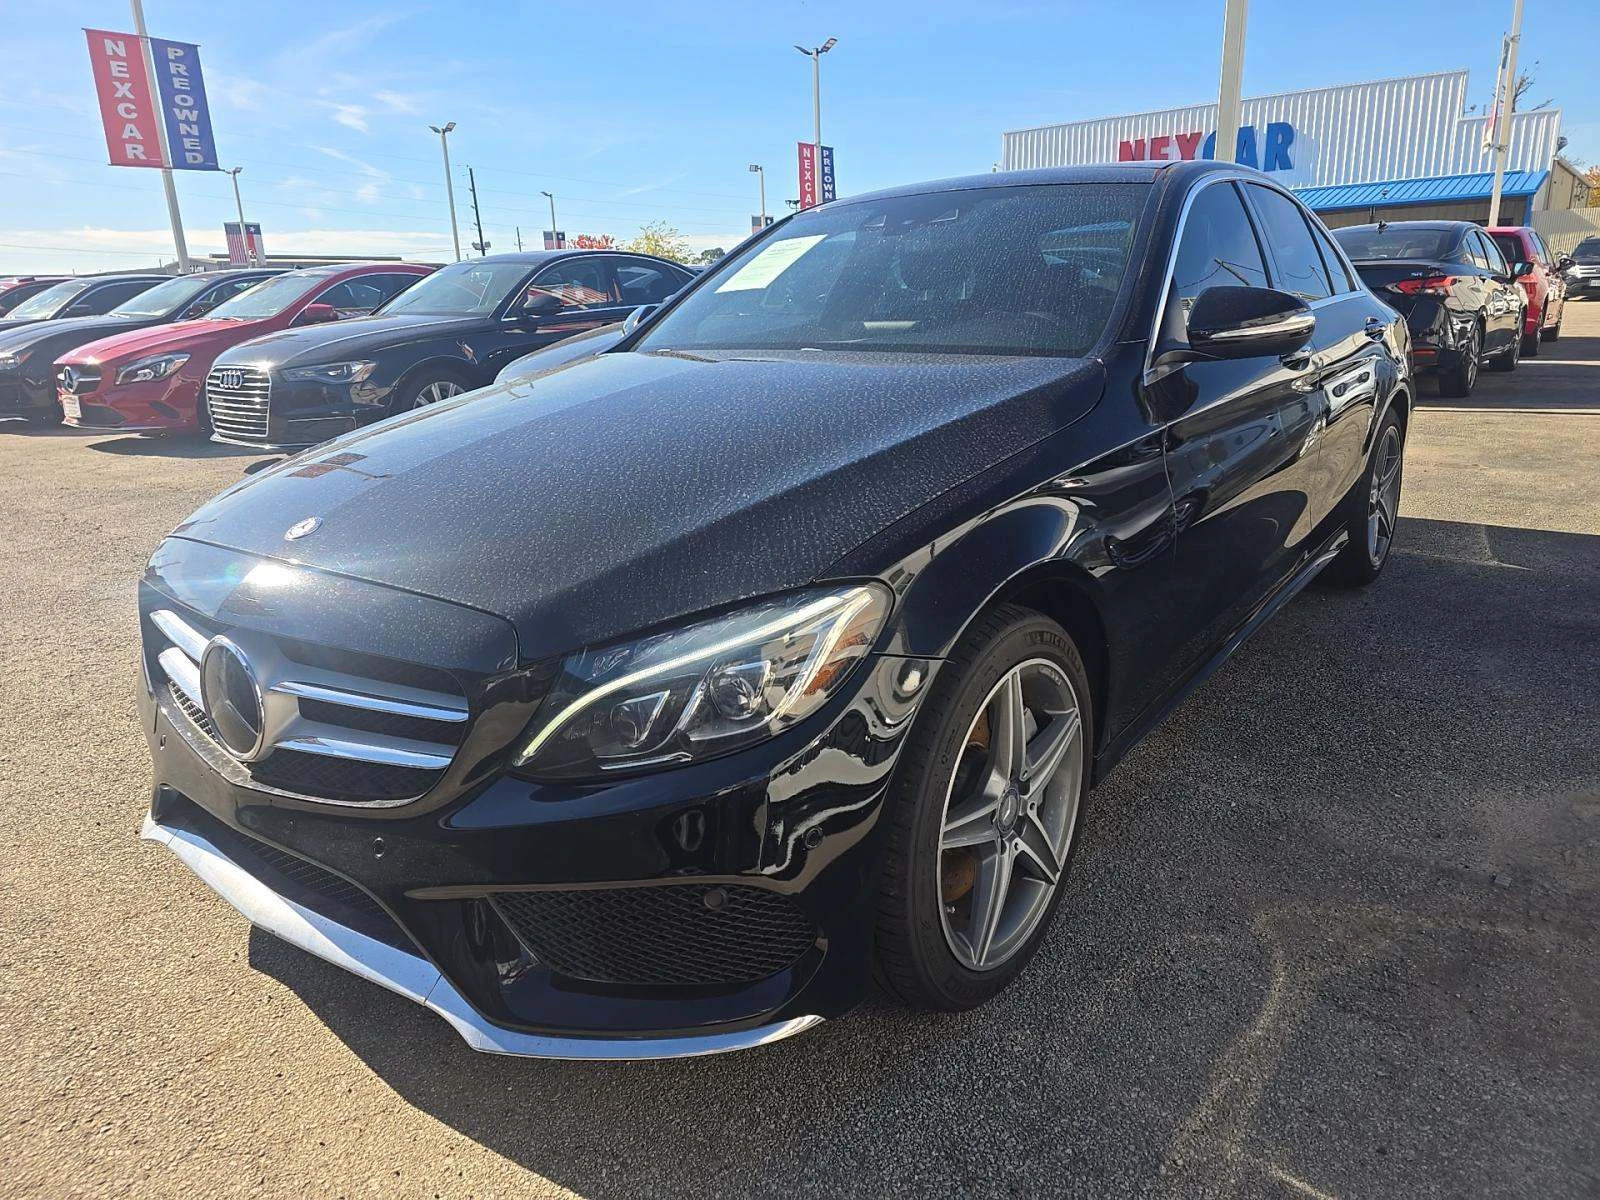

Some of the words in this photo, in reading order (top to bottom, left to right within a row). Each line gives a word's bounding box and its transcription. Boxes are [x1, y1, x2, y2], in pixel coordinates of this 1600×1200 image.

[103, 38, 147, 160] NEXCAR
[166, 47, 204, 164] PREOWNED
[803, 147, 812, 209] NEXCA
